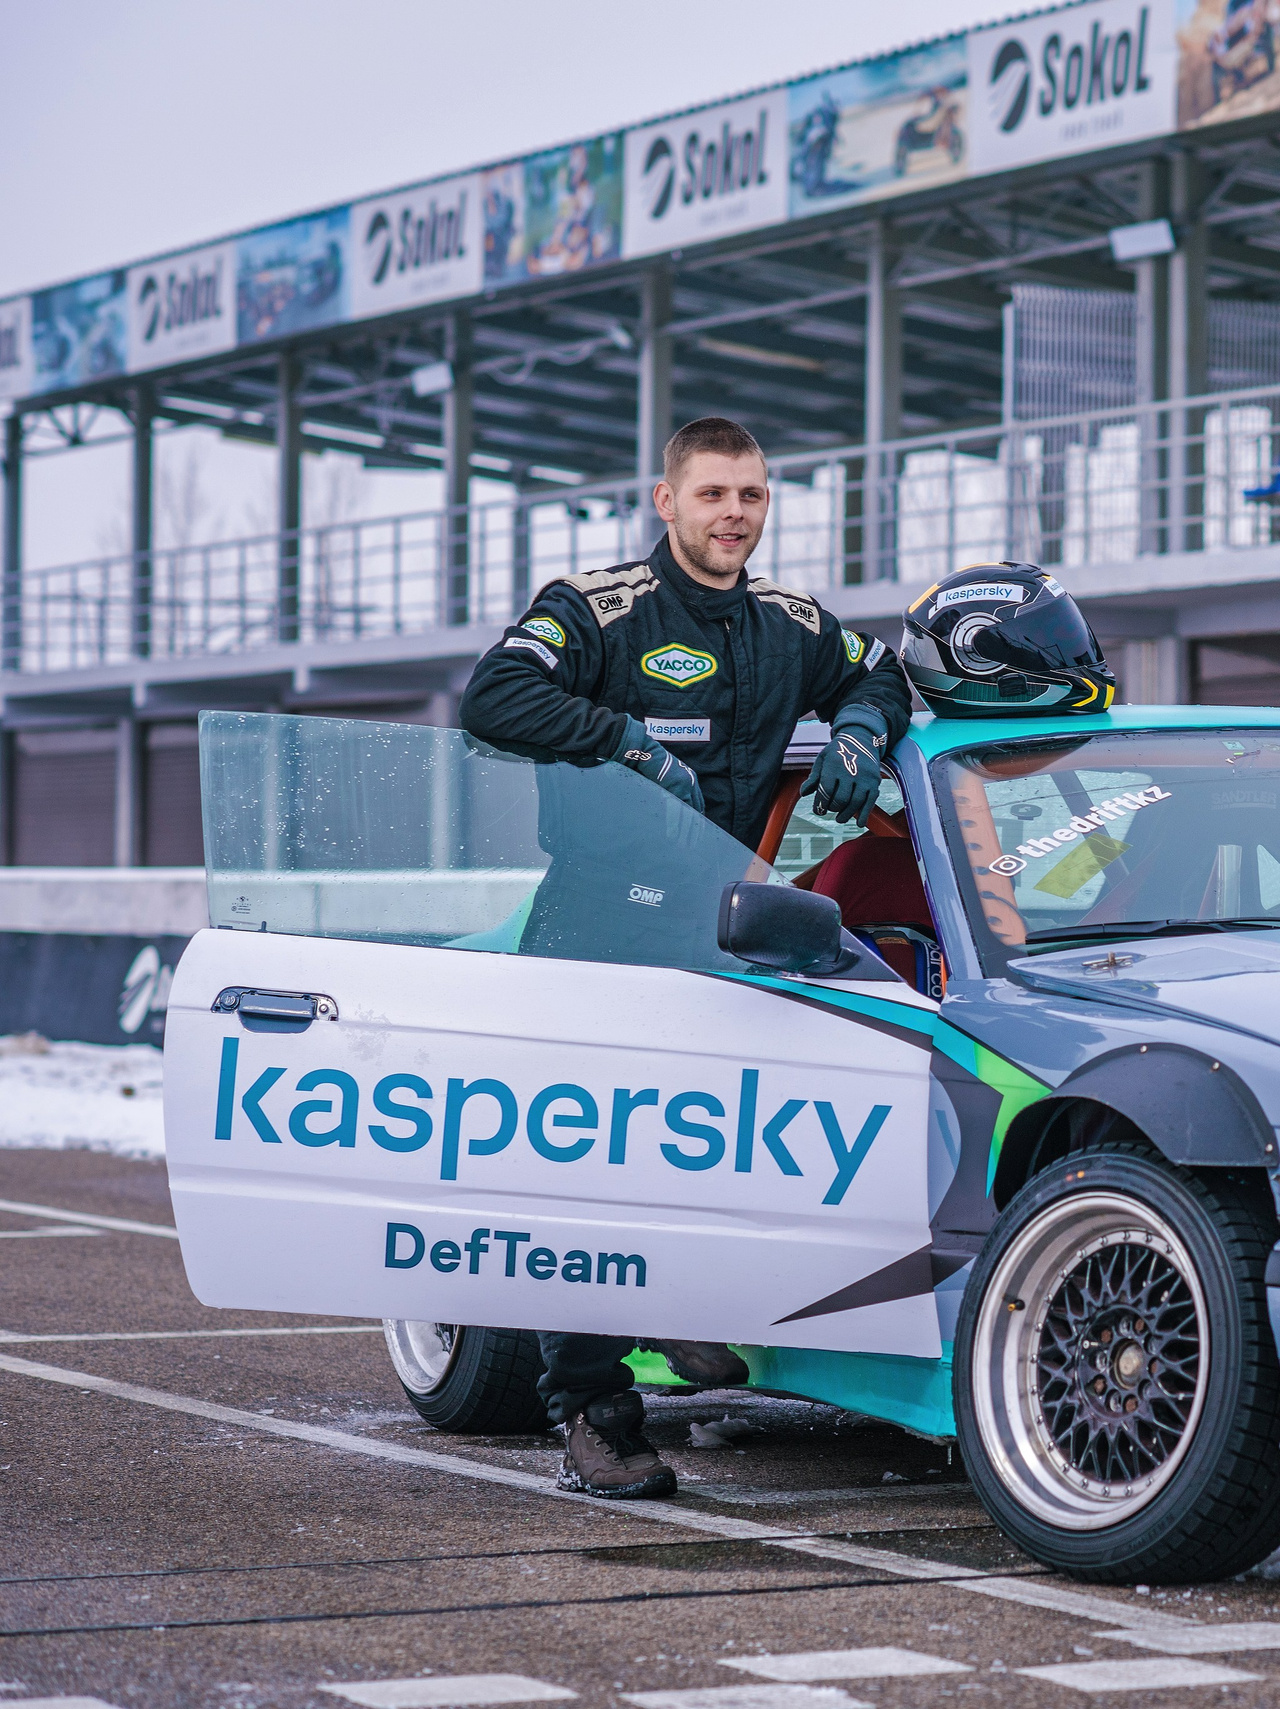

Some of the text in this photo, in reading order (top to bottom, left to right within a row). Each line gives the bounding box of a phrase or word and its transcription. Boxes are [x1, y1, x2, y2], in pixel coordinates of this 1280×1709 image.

[945, 585, 1012, 602] kaspersky
[598, 595, 624, 610] OMP
[788, 603, 814, 620] OMP
[524, 622, 560, 640] YACCO
[512, 639, 551, 660] kaspersky
[653, 658, 706, 673] YACCO
[650, 722, 705, 736] kaspersky
[1016, 785, 1172, 858] thedriftkz
[629, 887, 664, 905] OMP
[214, 1037, 892, 1206] kaspersky
